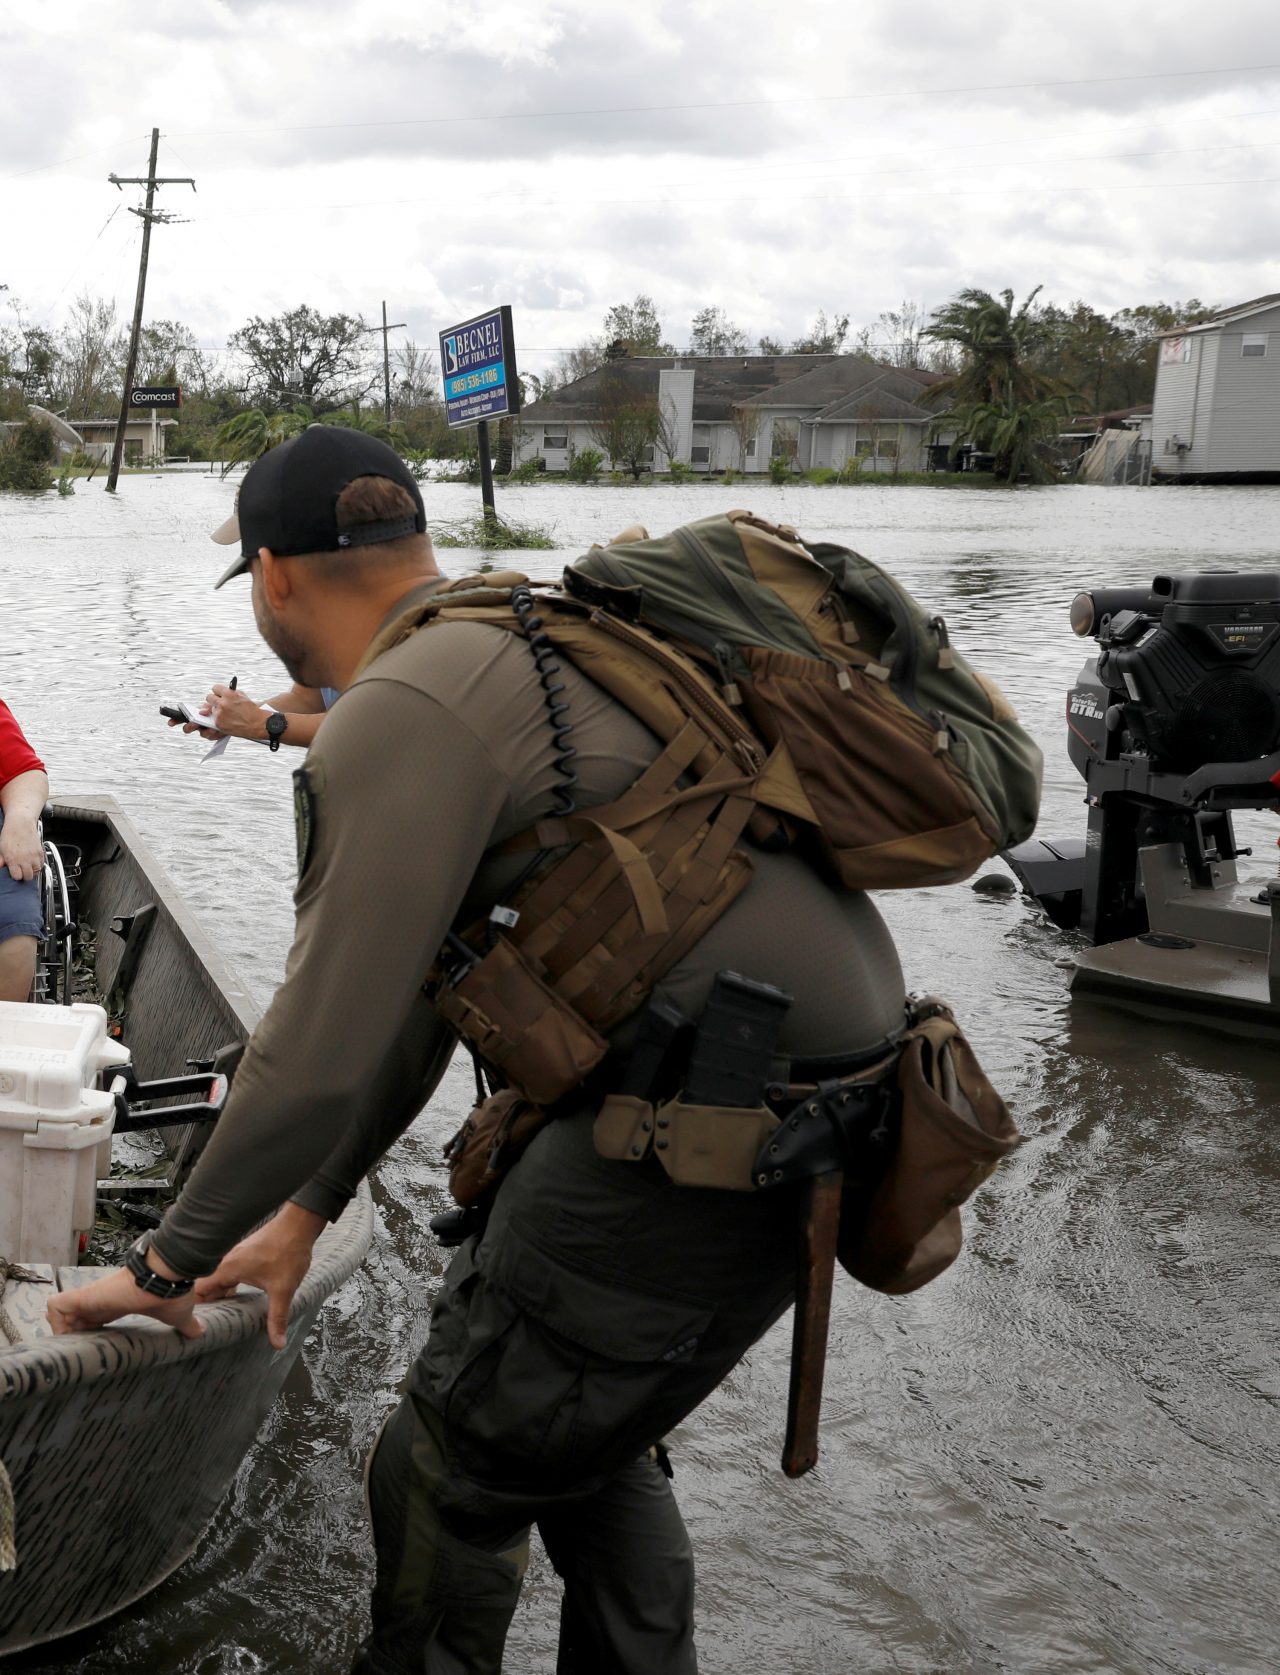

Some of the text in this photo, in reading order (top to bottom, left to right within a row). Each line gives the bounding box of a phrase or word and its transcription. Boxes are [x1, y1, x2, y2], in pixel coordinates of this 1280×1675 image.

[457, 323, 498, 355] BECNEL
[458, 344, 500, 368] LAW FIRM, LLC
[451, 379, 467, 394] (985)
